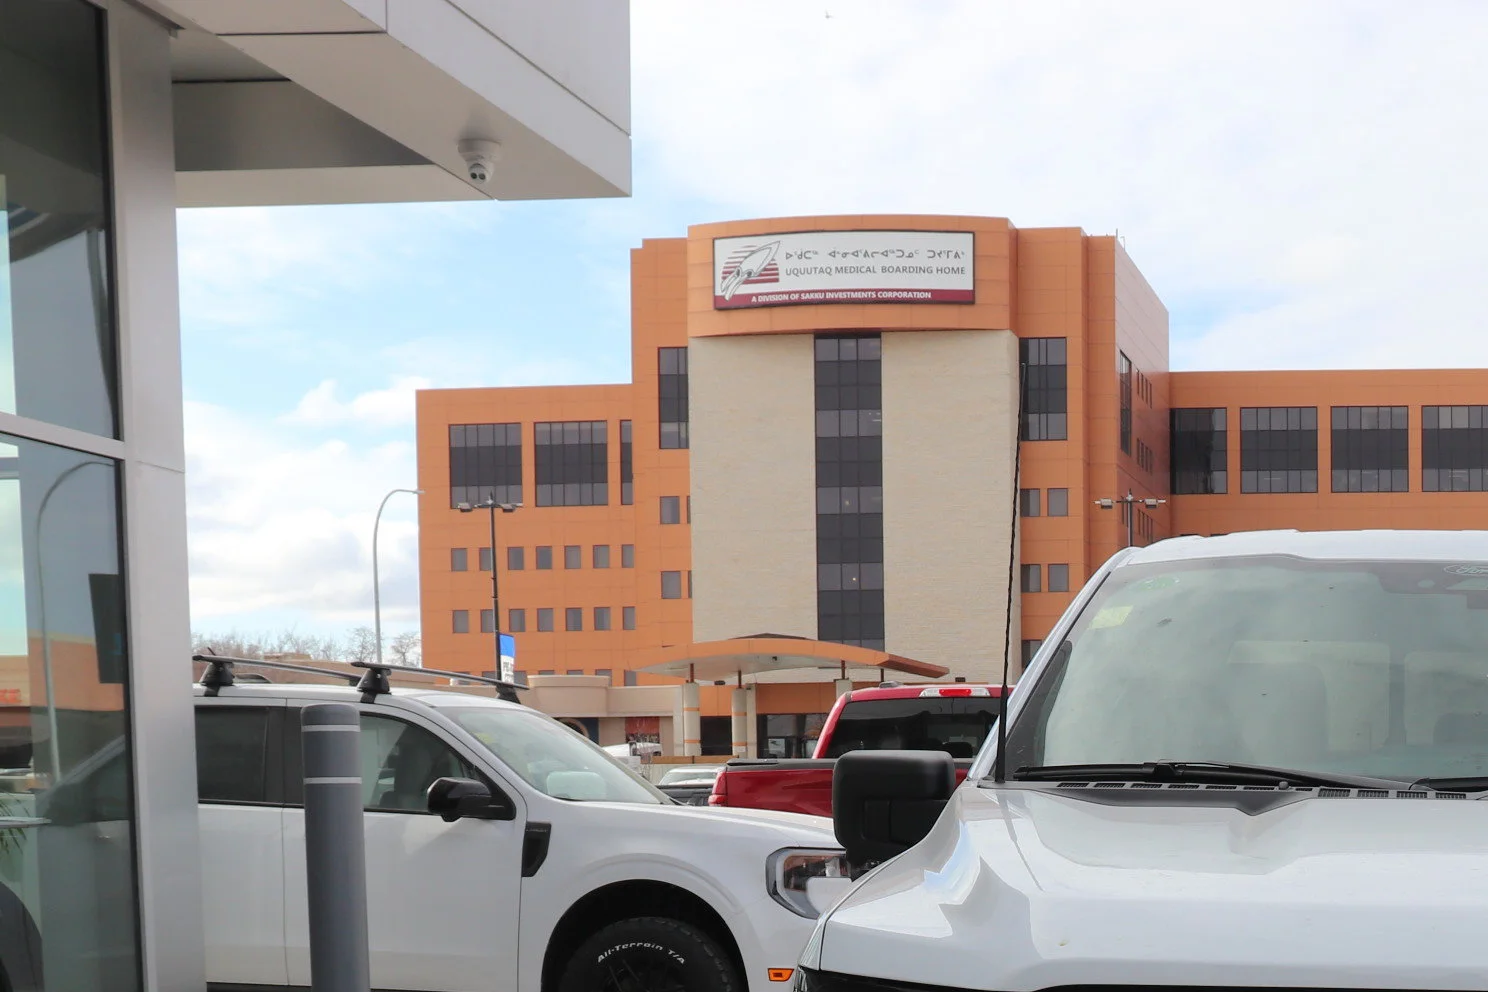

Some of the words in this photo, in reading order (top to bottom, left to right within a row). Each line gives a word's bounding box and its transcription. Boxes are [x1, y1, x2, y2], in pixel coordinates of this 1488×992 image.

[785, 266, 833, 277] UQUUTAQ
[834, 265, 877, 275] MEDICAL
[881, 265, 934, 275] BOARDING
[936, 266, 966, 275] HOME
[751, 295, 757, 303] A
[757, 294, 790, 302] DIVISION
[790, 293, 800, 301] OF
[800, 292, 825, 300] SAKKU
[825, 291, 877, 299] INVESTMENTS
[877, 291, 932, 299] CORPORATION
[597, 942, 664, 963] All-Terrain
[667, 949, 686, 964] T/A
